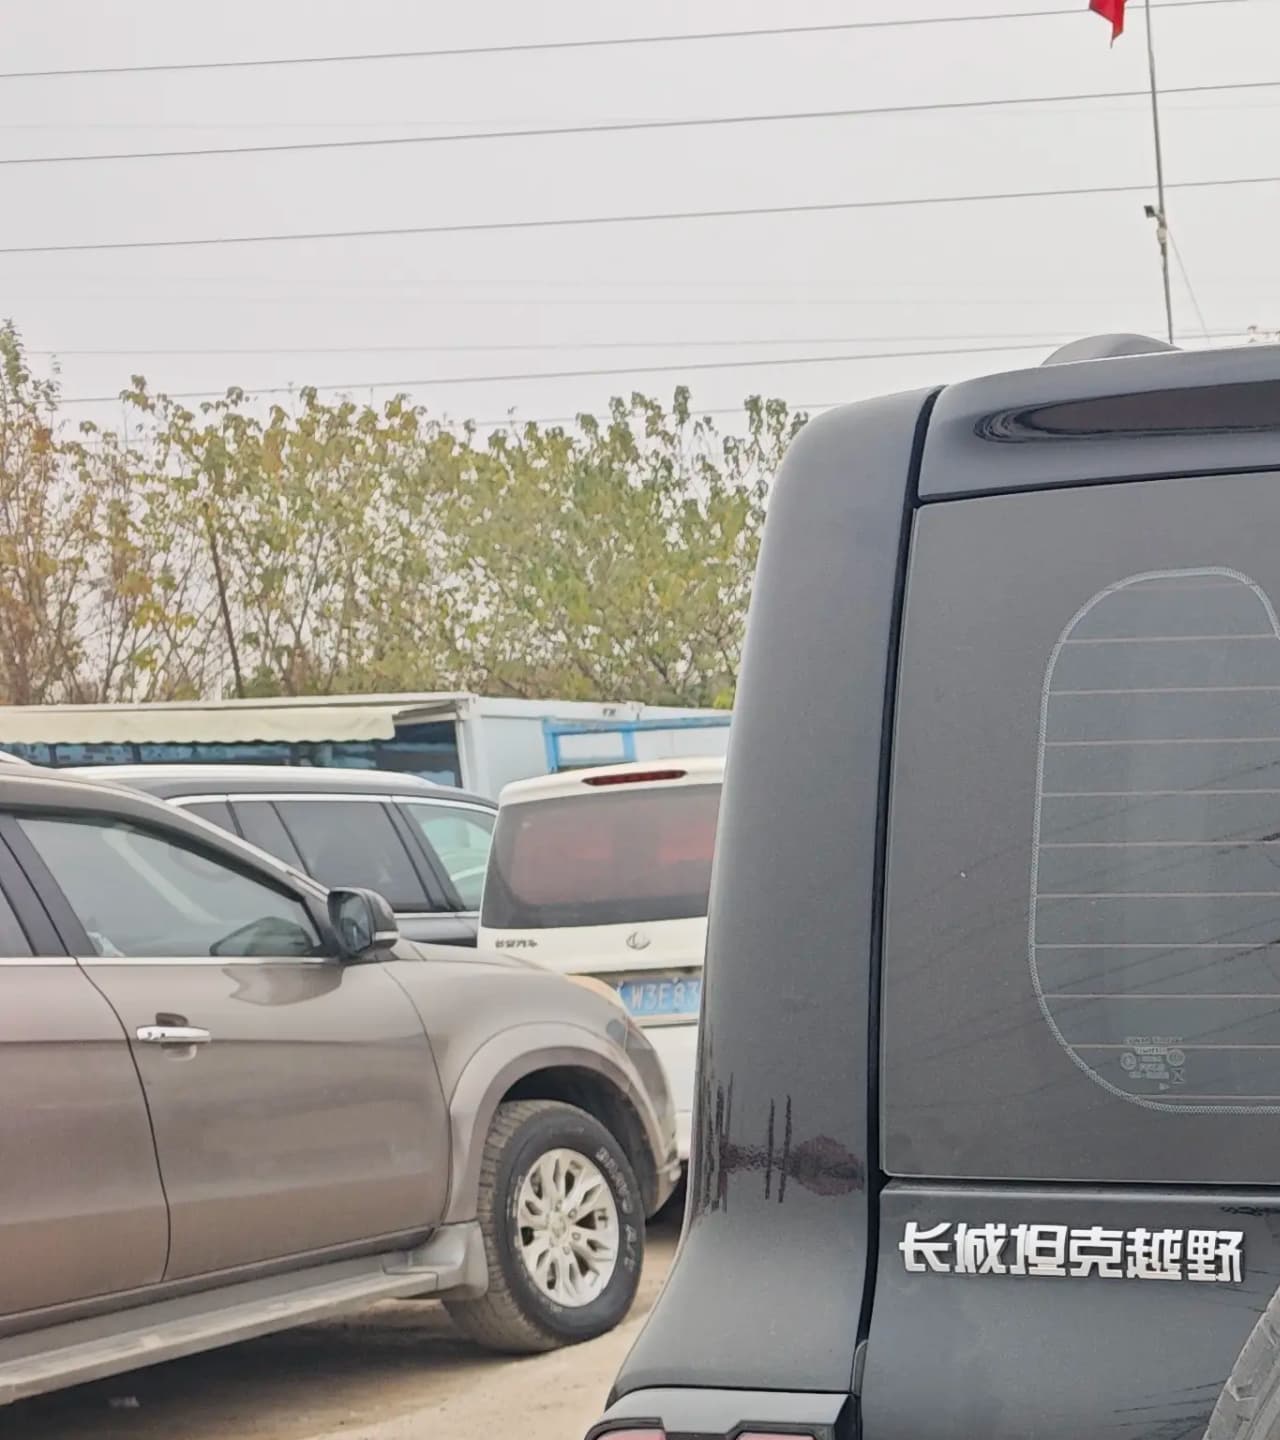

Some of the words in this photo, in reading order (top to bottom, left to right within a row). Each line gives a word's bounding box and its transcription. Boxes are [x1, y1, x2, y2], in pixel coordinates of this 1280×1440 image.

[898, 1221, 1245, 1284] 长城坦克越野
